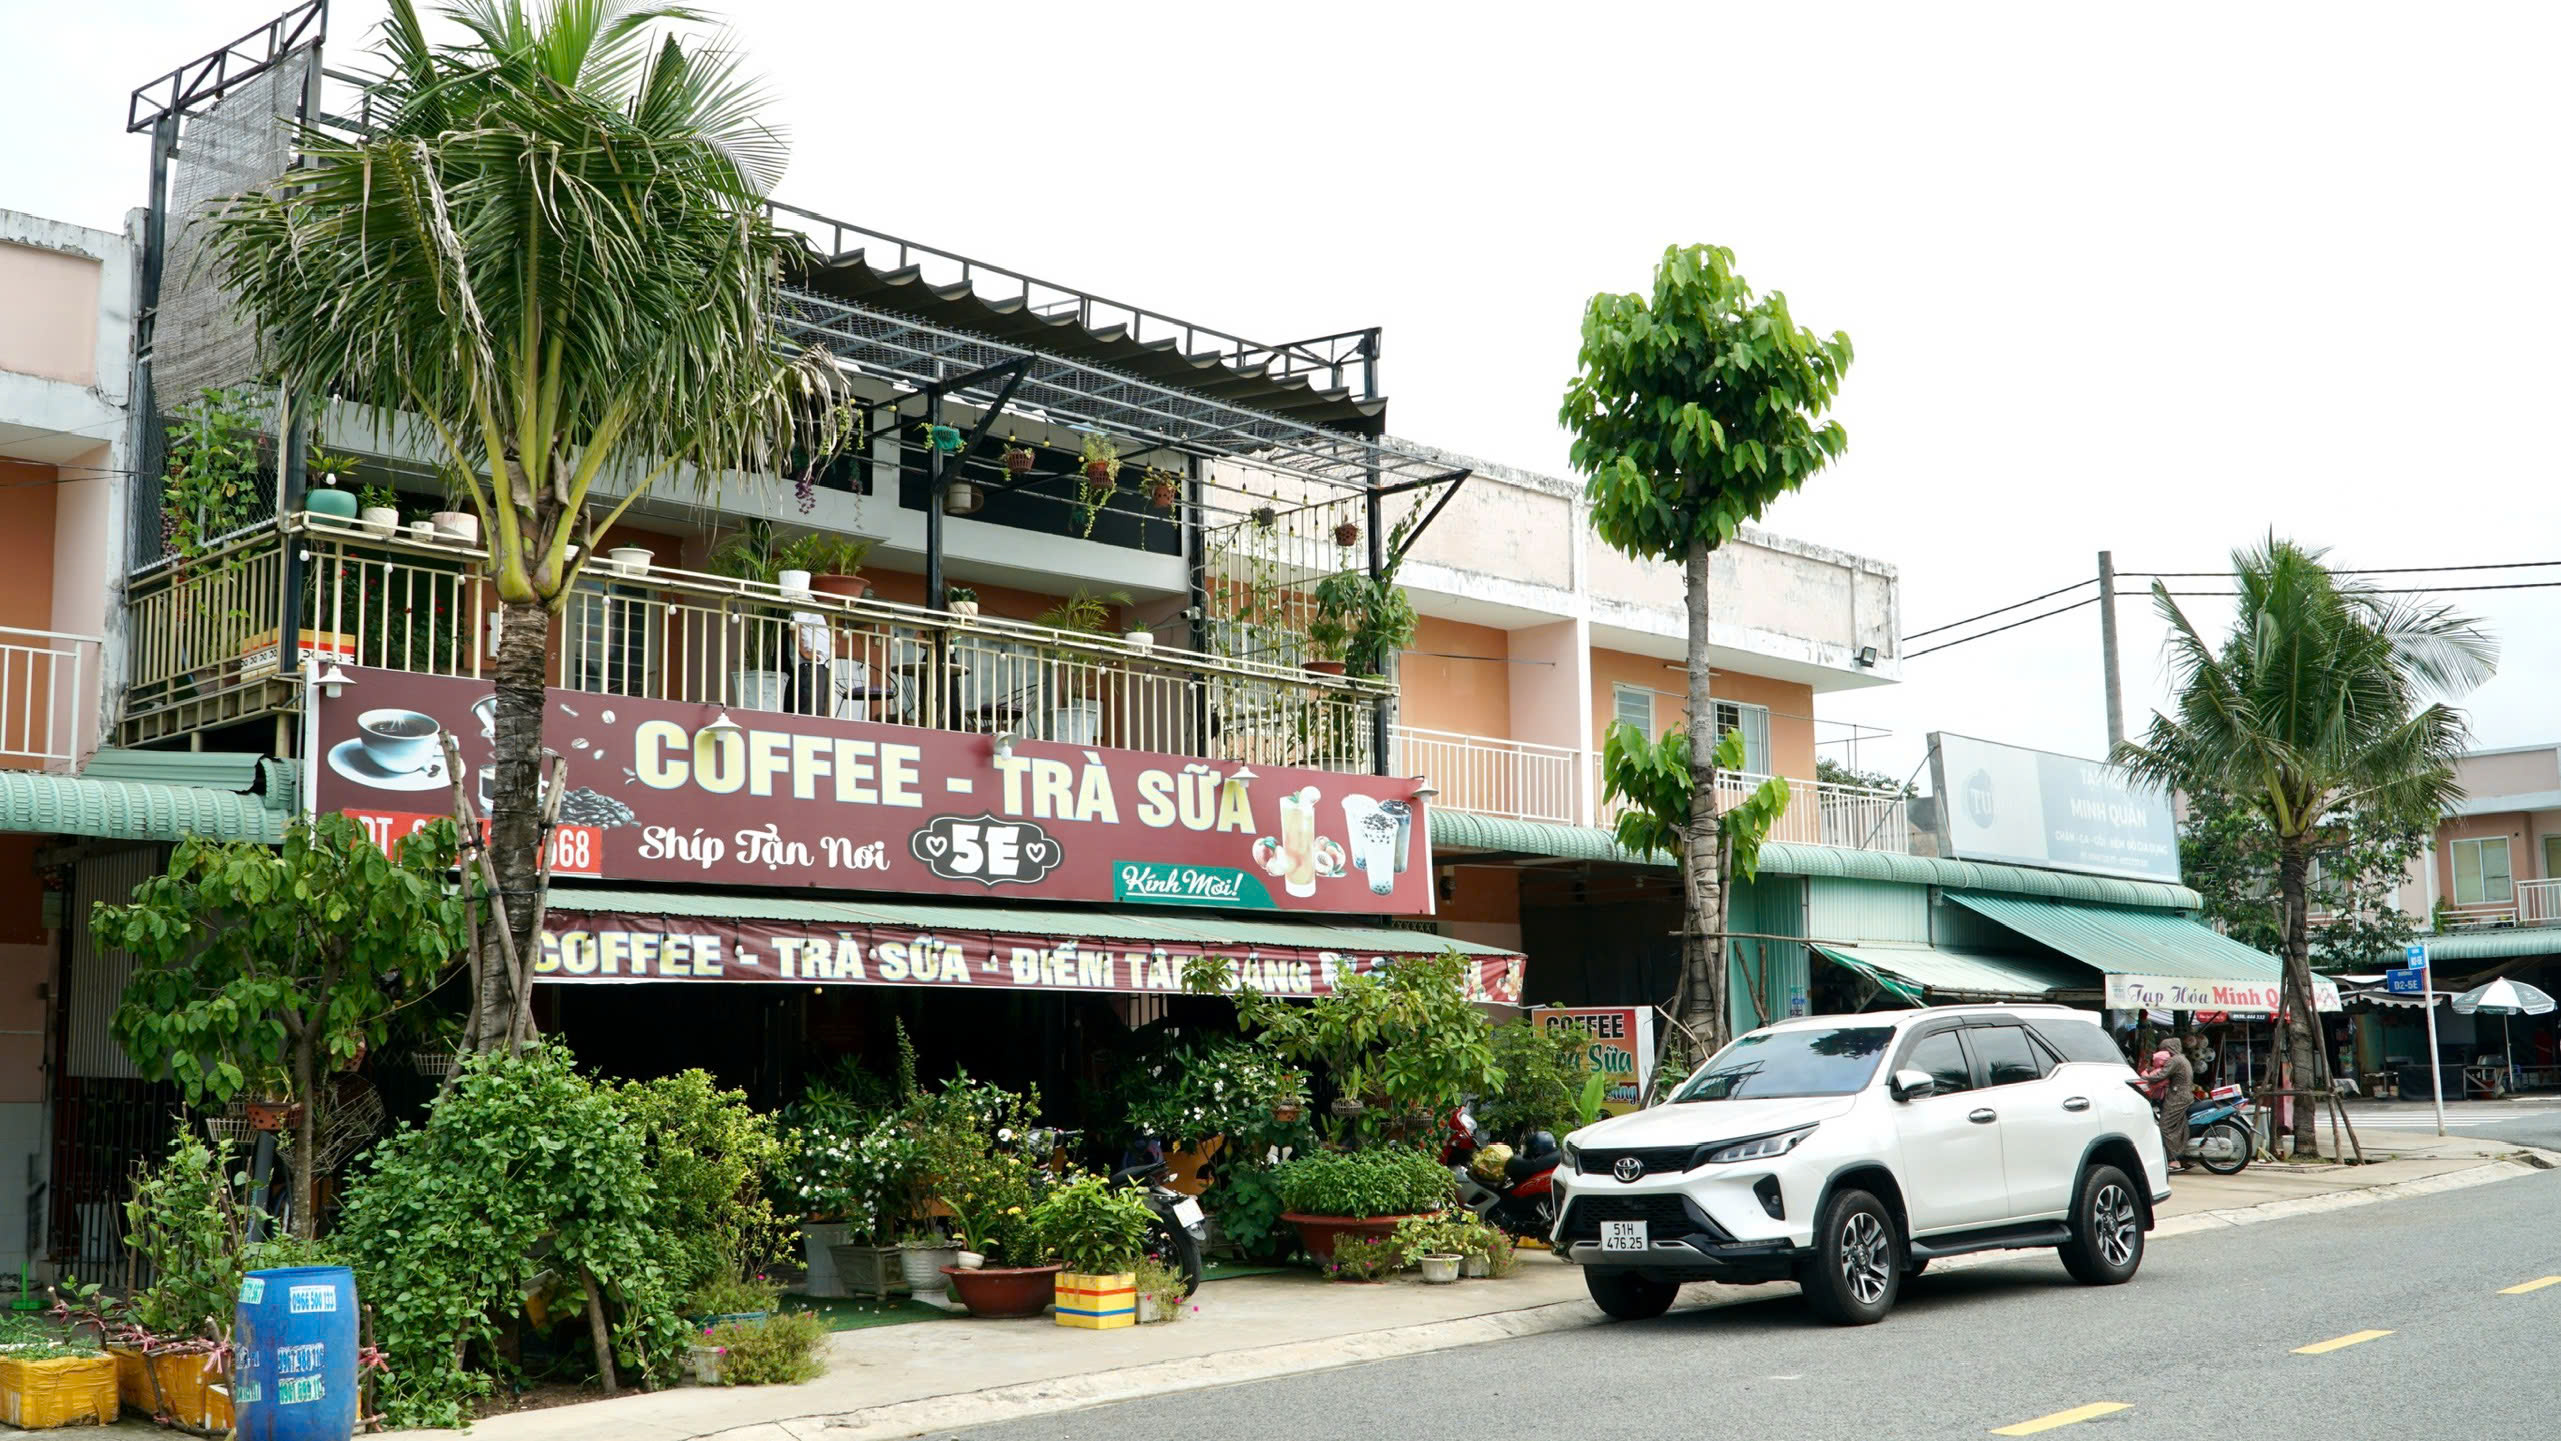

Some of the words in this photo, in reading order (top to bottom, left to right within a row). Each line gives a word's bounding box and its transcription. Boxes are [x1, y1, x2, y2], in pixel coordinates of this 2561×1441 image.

[635, 719, 923, 809] COFFEE
[993, 751, 1120, 825] TRÀ
[1136, 763, 1257, 834] SỮA
[2070, 797, 2107, 823] MINH
[637, 825, 726, 870] Shíp
[735, 823, 815, 871] Tận
[820, 836, 891, 871] Nơi
[950, 823, 1020, 876] 5E
[1121, 866, 1184, 894] Kính
[1184, 873, 1243, 896] Mời!
[535, 930, 723, 976] COFFEE
[771, 931, 867, 980] TRÀ
[879, 936, 971, 983] SỮA
[2212, 987, 2261, 1005] Minh
[2393, 980, 2418, 990] D2-5E
[1546, 1014, 1624, 1039] COFFEE
[1588, 1043, 1633, 1073] Sữa
[1607, 1237, 1642, 1249] 476.25
[1614, 1223, 1633, 1235] 51H
